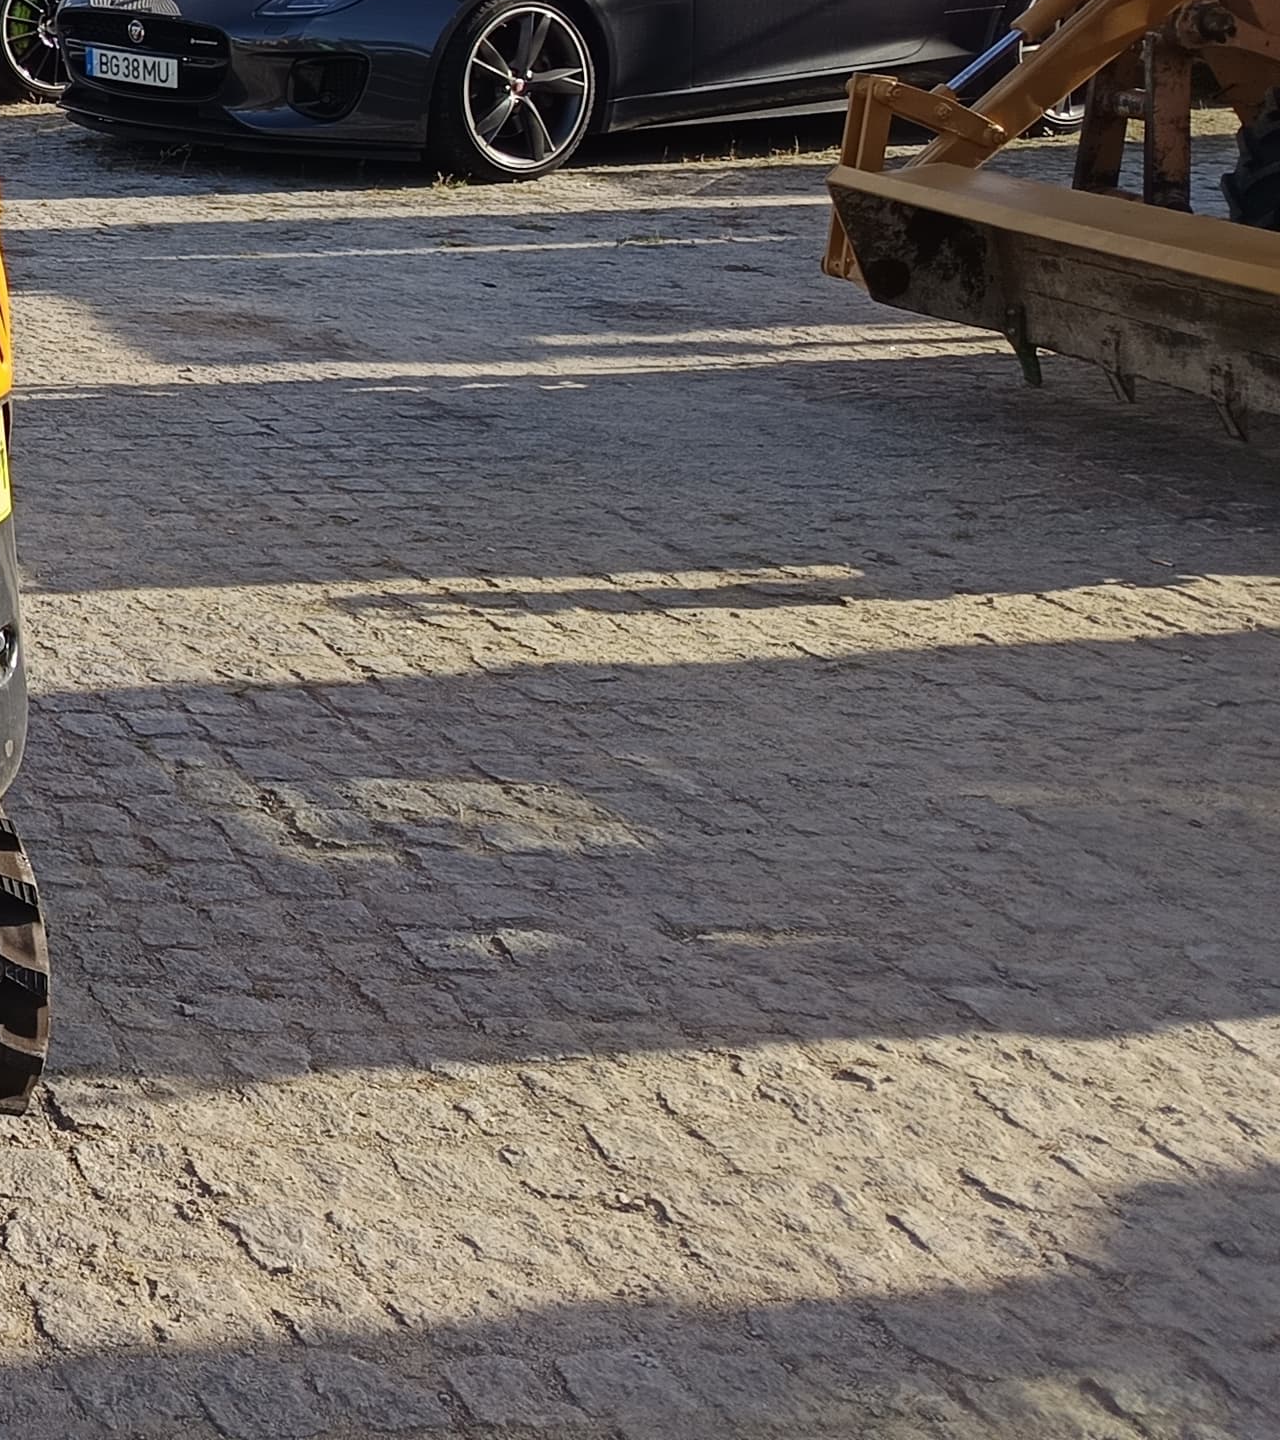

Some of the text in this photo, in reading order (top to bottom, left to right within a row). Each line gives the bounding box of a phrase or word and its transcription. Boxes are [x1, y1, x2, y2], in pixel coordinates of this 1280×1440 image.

[99, 53, 169, 84] BG 38 MU
